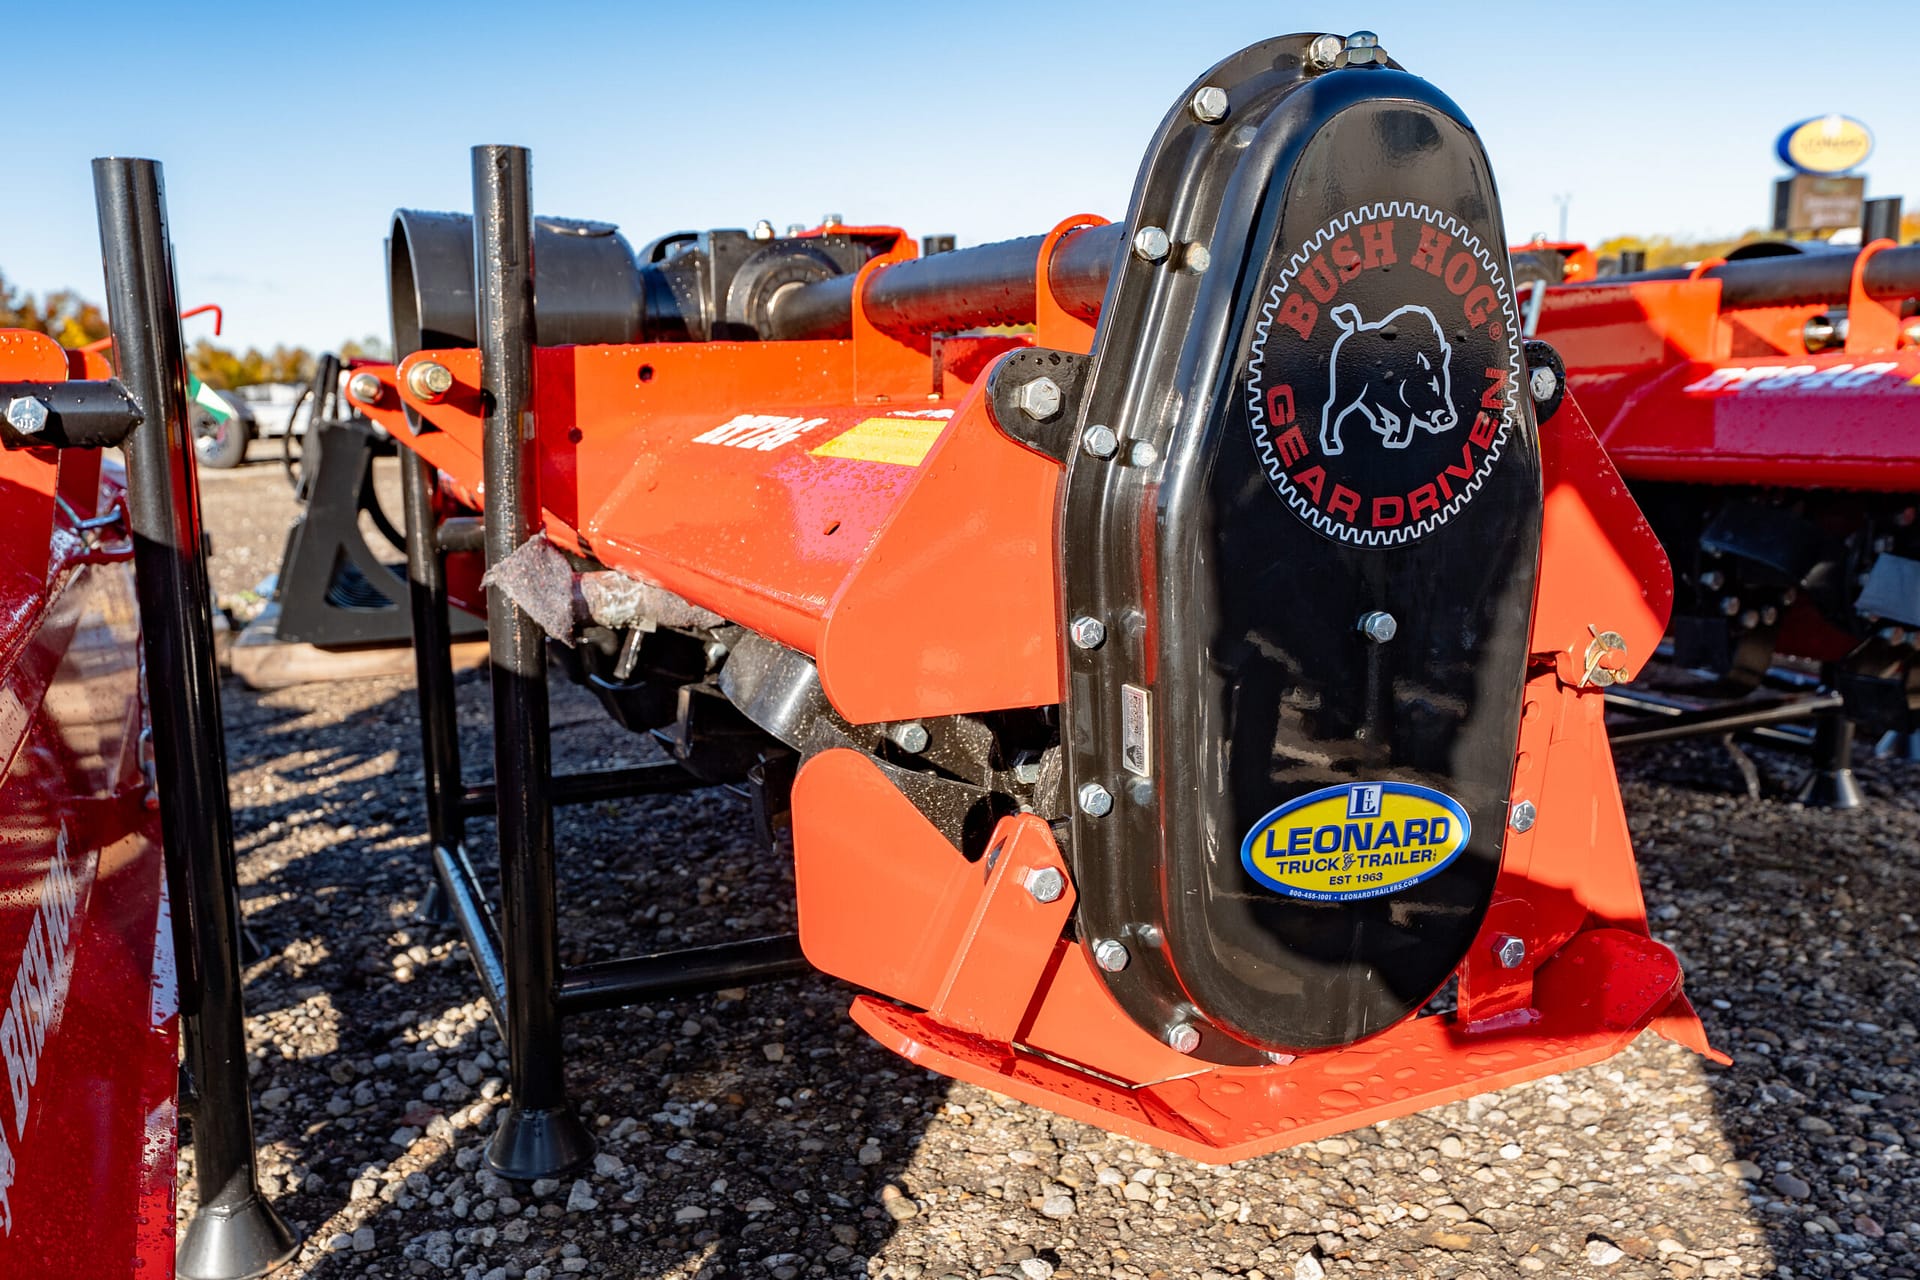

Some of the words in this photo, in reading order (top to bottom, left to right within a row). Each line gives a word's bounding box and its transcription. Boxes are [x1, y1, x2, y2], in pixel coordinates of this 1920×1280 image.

[1277, 221, 1398, 340] BUSH
[1266, 383, 1363, 523] GEAR
[1371, 367, 1508, 528] DRIVEN
[1264, 816, 1451, 859] LEONARD
[1276, 857, 1341, 875] TRUCK
[1356, 848, 1433, 869] TRAILER
[1329, 874, 1352, 886] EST
[1355, 871, 1384, 883] 1963
[1288, 888, 1333, 901] 800-455-1001
[1339, 877, 1420, 901] LEONARDTRAILERS.COM
[0, 908, 53, 1142] BUSH
